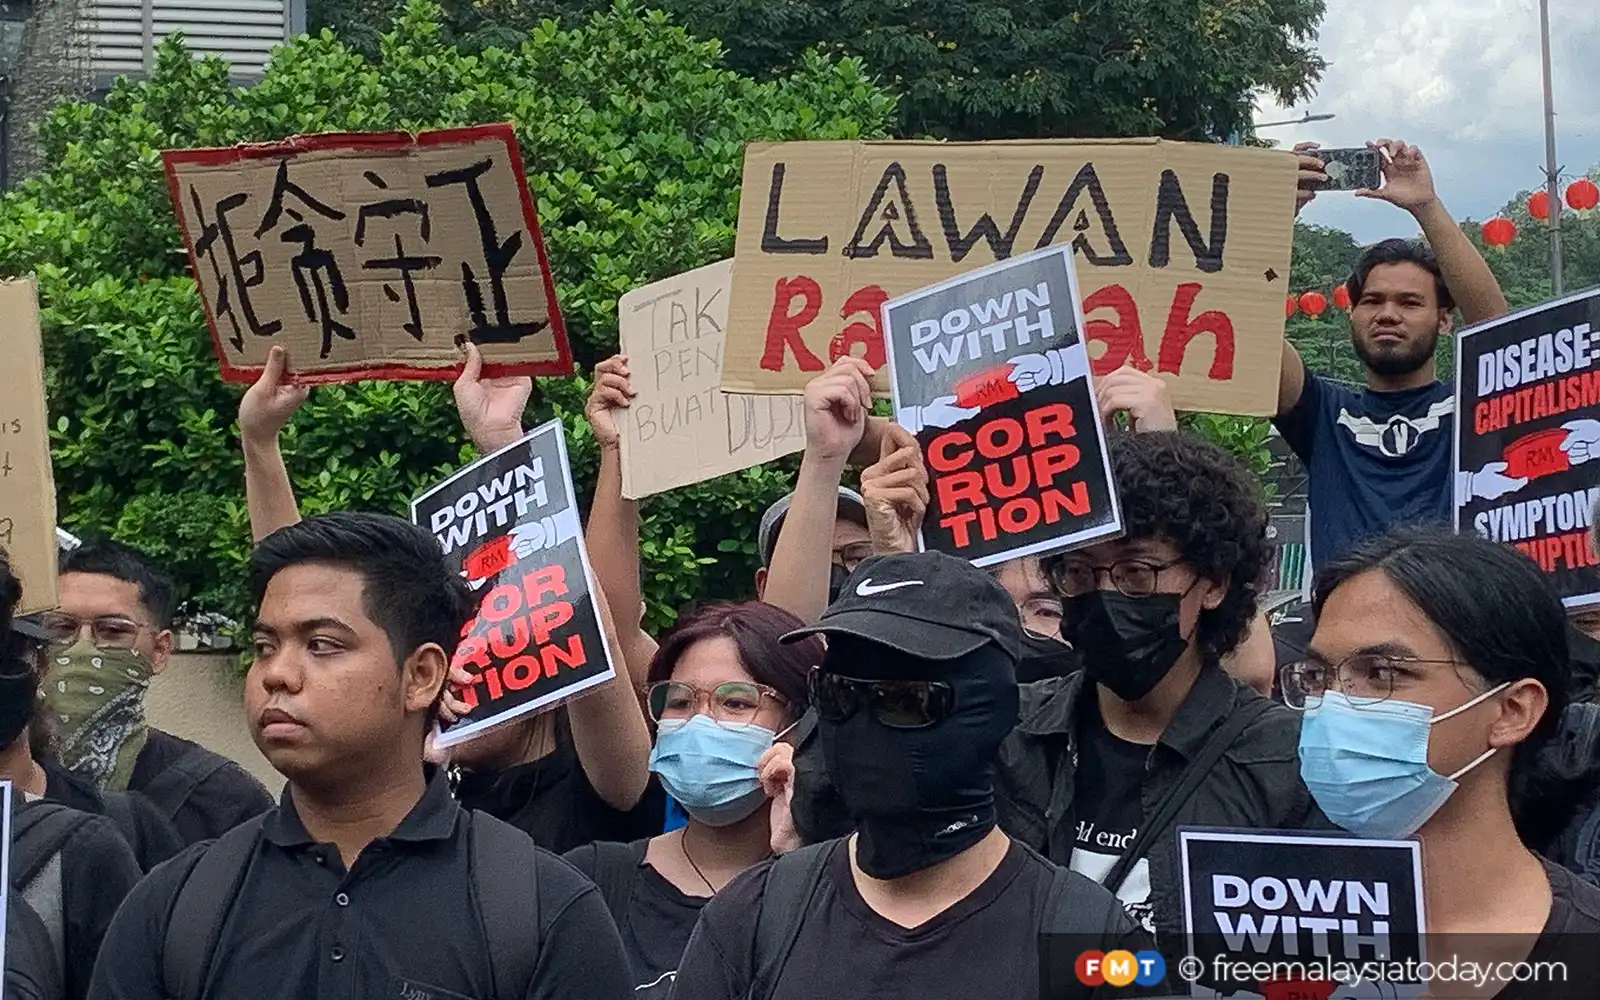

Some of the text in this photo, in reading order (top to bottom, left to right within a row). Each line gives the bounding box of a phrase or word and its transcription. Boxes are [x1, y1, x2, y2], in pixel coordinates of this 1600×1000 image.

[761, 161, 1229, 273] LAWAN
[190, 158, 549, 358] 拒贪守正
[633, 287, 722, 350] TAK
[760, 275, 1235, 380] Raah
[910, 282, 1050, 347] DOWN
[912, 308, 1054, 374] WITH
[976, 377, 1004, 398] RM
[1478, 323, 1600, 398] DISEASE:
[636, 386, 721, 442] BUAT
[1474, 370, 1600, 435] CAPITALISM
[928, 404, 1078, 472] COR
[431, 456, 544, 534] DOWN
[936, 444, 1081, 515] RUP
[437, 480, 548, 554] WITH
[940, 481, 1090, 549] TION
[481, 547, 508, 572] RM
[461, 564, 569, 637] OR
[1075, 821, 1094, 843] ld
[1212, 874, 1390, 916] DOWN
[1213, 911, 1391, 961] WITH
